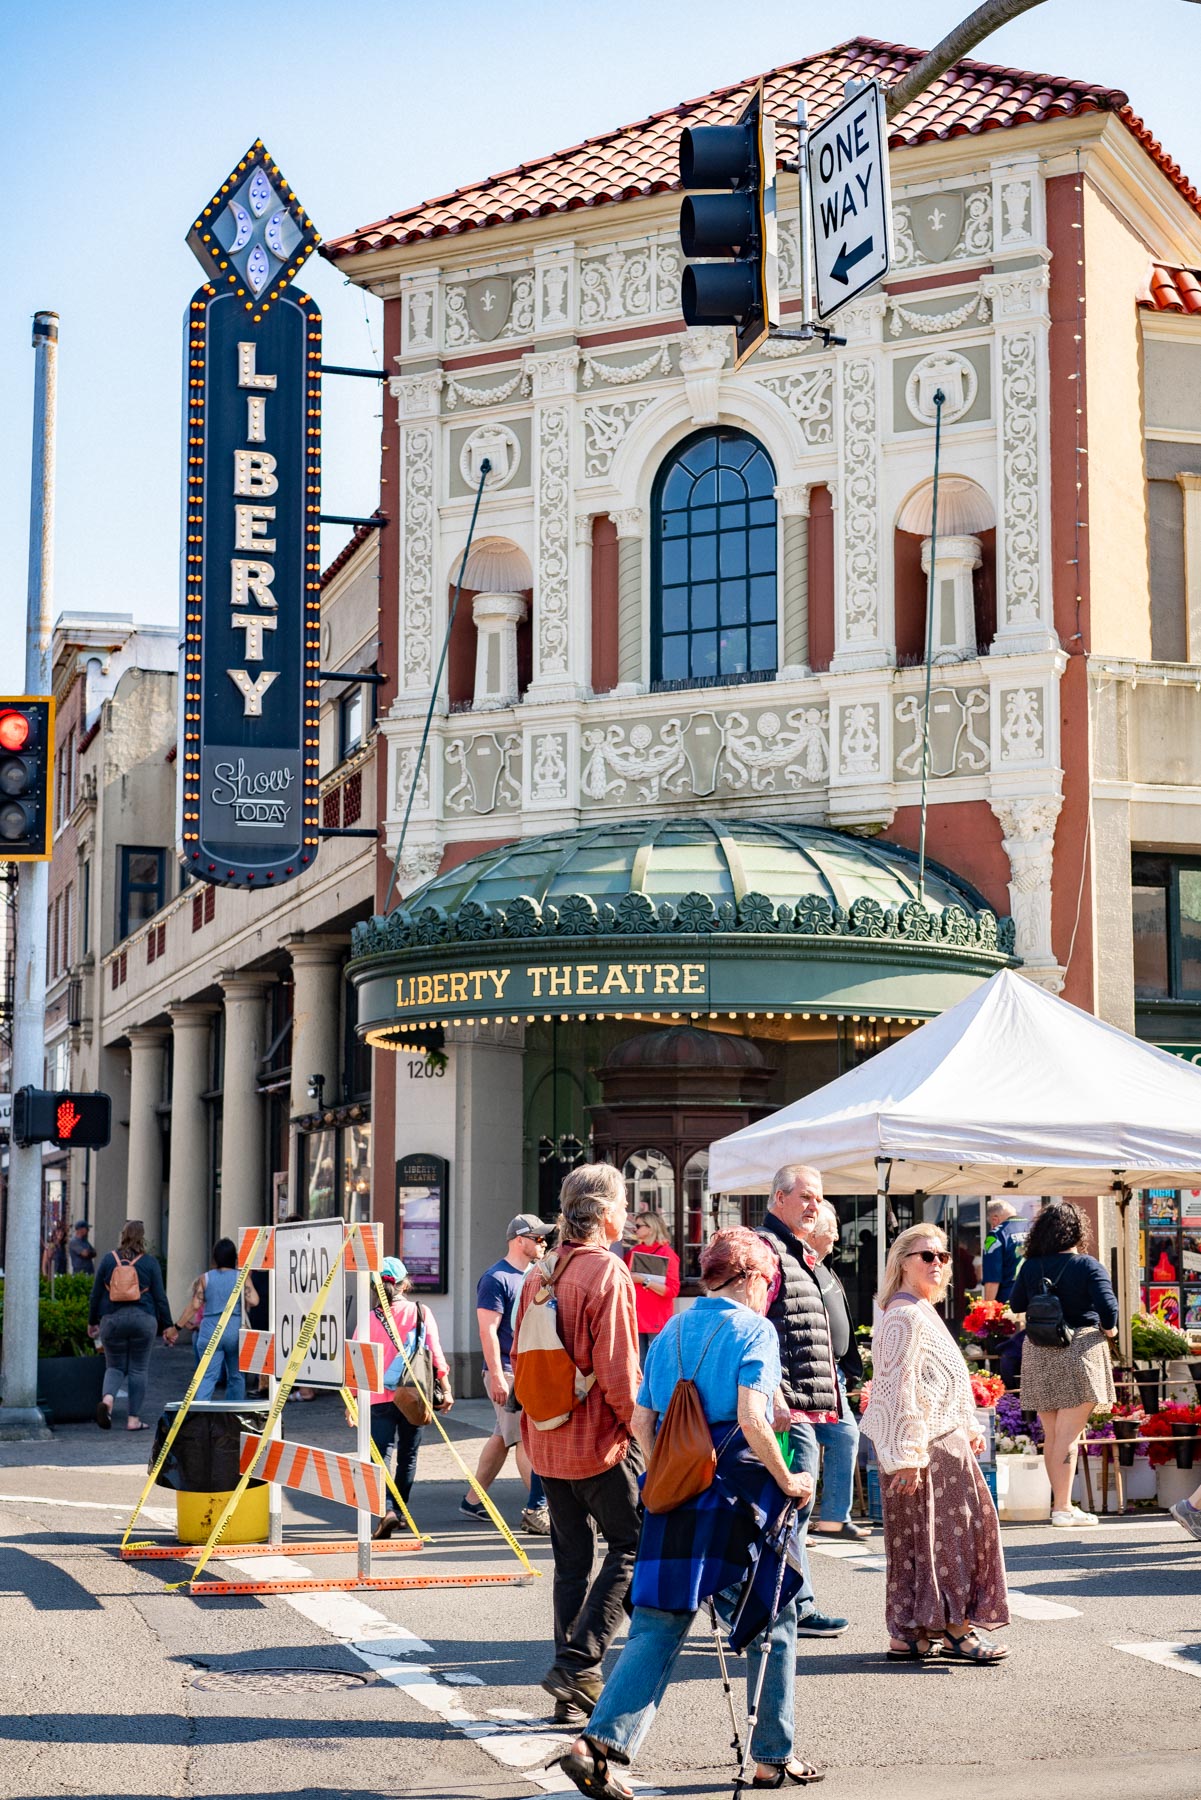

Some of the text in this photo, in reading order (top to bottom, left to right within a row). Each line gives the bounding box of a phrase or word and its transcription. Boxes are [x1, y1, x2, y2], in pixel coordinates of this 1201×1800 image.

[820, 110, 870, 183] ONE
[820, 162, 873, 239] WAY
[227, 341, 281, 717] LIBERTY
[211, 757, 295, 805] Show
[231, 803, 291, 821] TODAY
[395, 963, 706, 1008] LIBERTY THEATRE
[407, 1060, 445, 1079] 1203
[403, 1165, 437, 1174] LIBERTY
[404, 1174, 437, 1182] THEATRE
[289, 1247, 329, 1293] ROAD
[281, 1314, 338, 1361] CLSED
